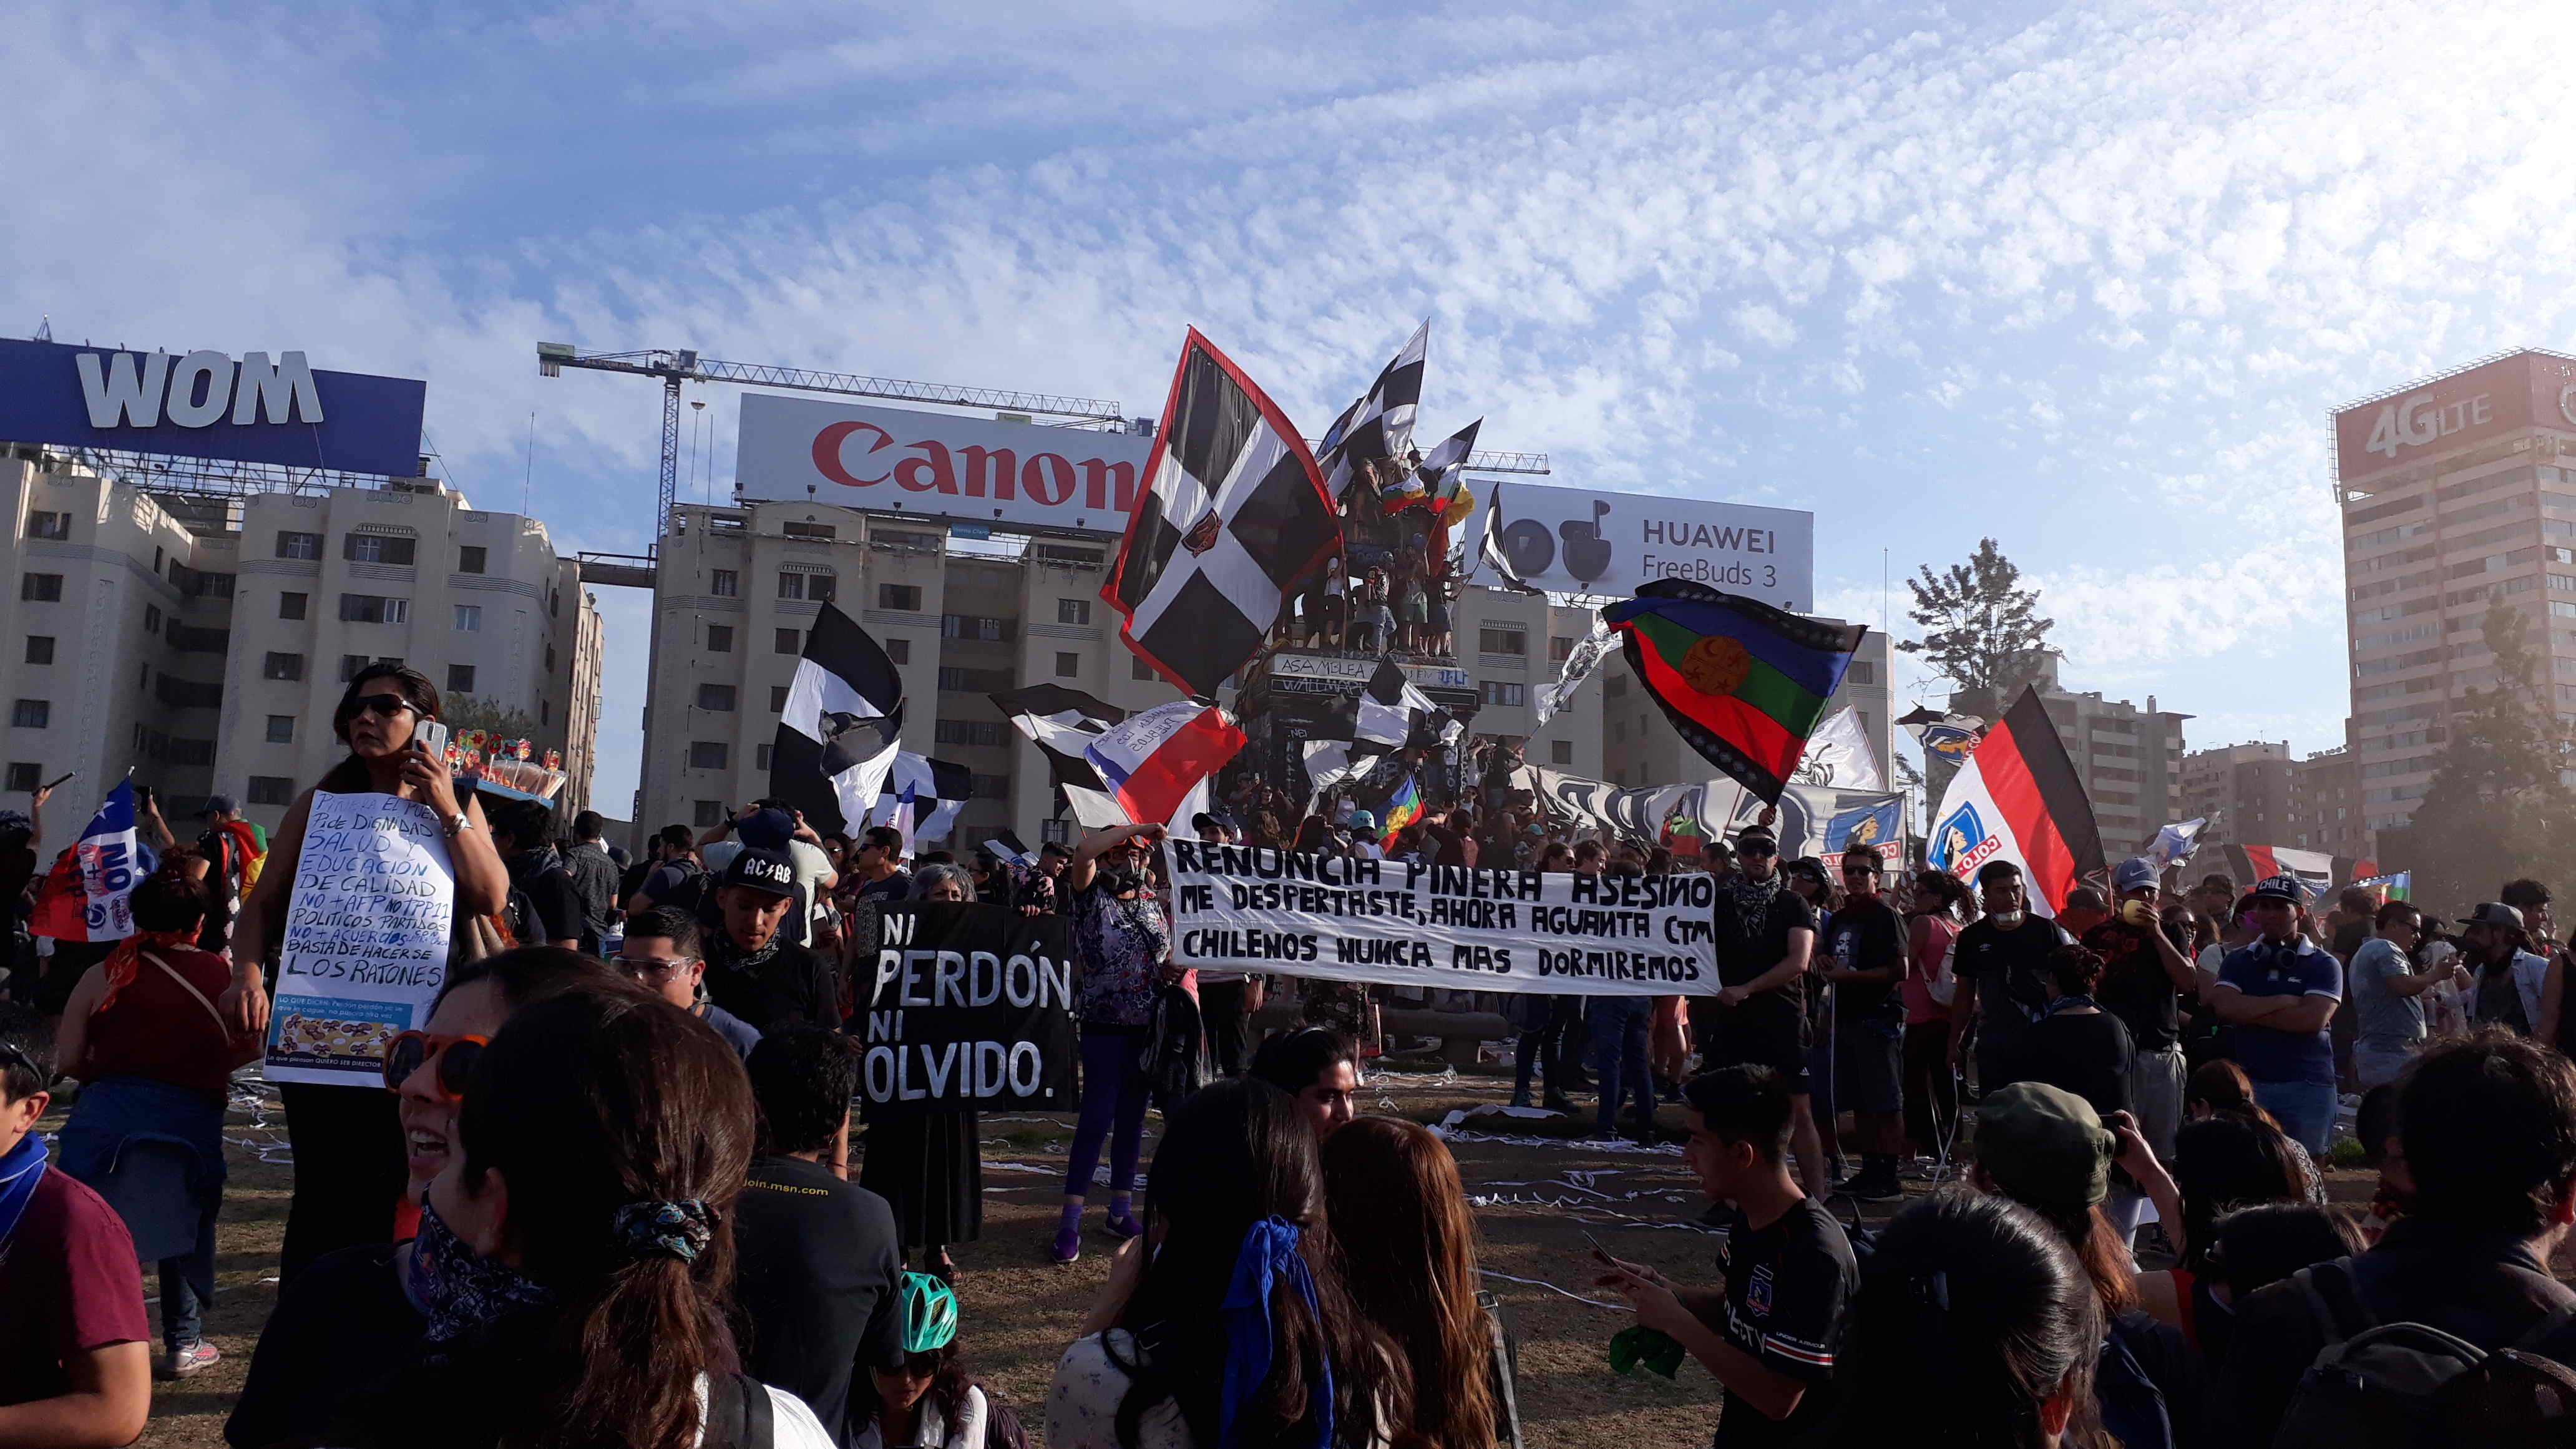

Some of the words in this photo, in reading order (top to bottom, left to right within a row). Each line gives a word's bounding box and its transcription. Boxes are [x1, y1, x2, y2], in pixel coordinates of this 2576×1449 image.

[76, 350, 324, 428] WOM
[812, 421, 1134, 513] Canon
[1643, 519, 1774, 554] HUAWEI
[1642, 554, 1752, 586] FreeBuds
[1763, 565, 1777, 587] 3
[1281, 658, 1365, 678] ASAMBLEA
[304, 829, 391, 853] SALUD
[99, 842, 132, 892] NO
[299, 874, 337, 891] DE
[1173, 839, 1380, 886] RENUNCIA
[1572, 873, 1712, 910] ASESINO
[2259, 879, 2290, 892] CHILE
[298, 892, 325, 909] NO
[330, 893, 344, 909] +
[344, 894, 387, 912] AFP
[384, 897, 402, 914] NO
[1180, 884, 1214, 914] ME
[1531, 906, 1651, 938] AGUANTA
[1664, 915, 1714, 945] CTM
[289, 925, 311, 938] NO
[883, 913, 915, 946] NI
[286, 939, 335, 954] BASTA
[337, 942, 361, 956] DE
[1183, 928, 1318, 962] CHILENOS
[1336, 937, 1434, 968] NUNCA
[1452, 944, 1511, 973] MAS
[1538, 948, 1700, 982] DORMIREMOS
[286, 954, 346, 978] LOS
[348, 959, 442, 988] RATONES
[867, 1009, 903, 1043] NI
[864, 1040, 1054, 1103] OLVIDO.
[1776, 1331, 1797, 1342] UNDER
